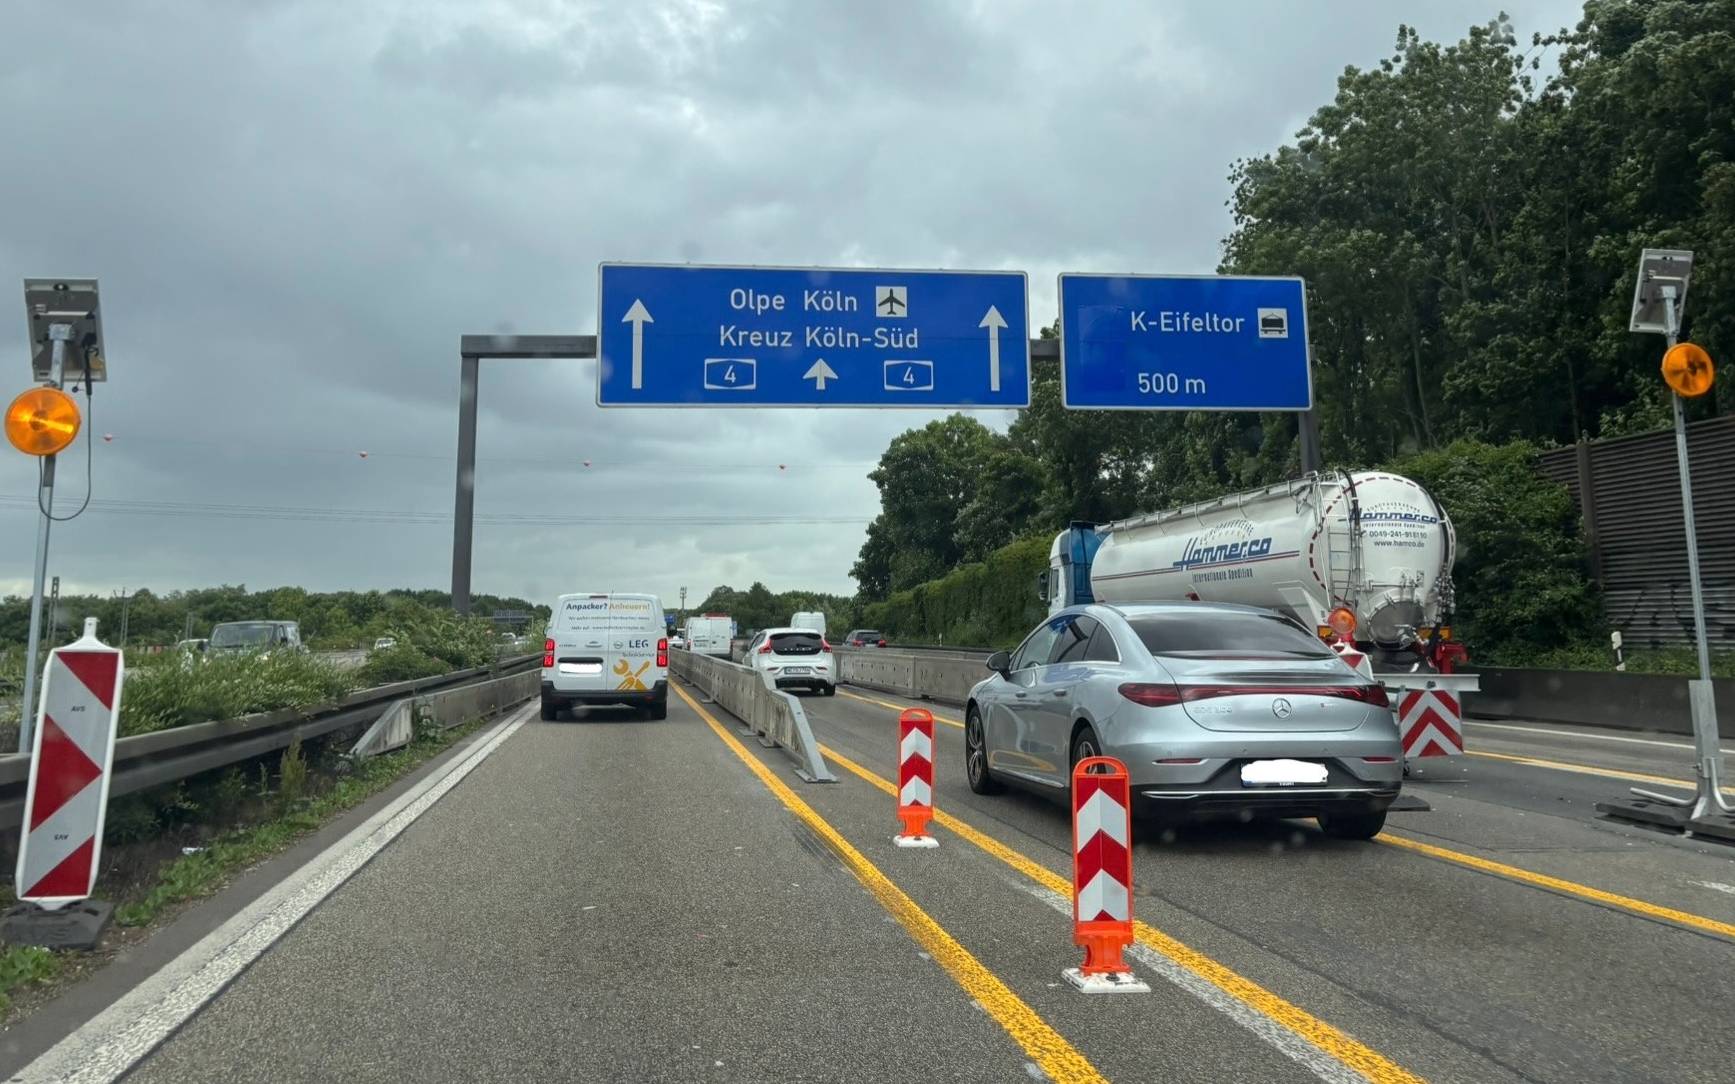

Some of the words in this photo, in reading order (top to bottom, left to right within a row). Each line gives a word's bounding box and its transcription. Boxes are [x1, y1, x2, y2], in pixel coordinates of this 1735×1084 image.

[730, 288, 785, 316] Olpe
[804, 290, 857, 312] Köln
[1131, 311, 1245, 333] K-Eifeltor
[720, 325, 793, 347] Kreuz
[805, 326, 918, 349] Köln-Süd
[724, 365, 737, 384] 4
[903, 366, 915, 385] 4
[1138, 373, 1178, 393] 500
[1185, 379, 1206, 393] m
[566, 603, 608, 612] Anpacker?
[629, 639, 649, 649] LEG
